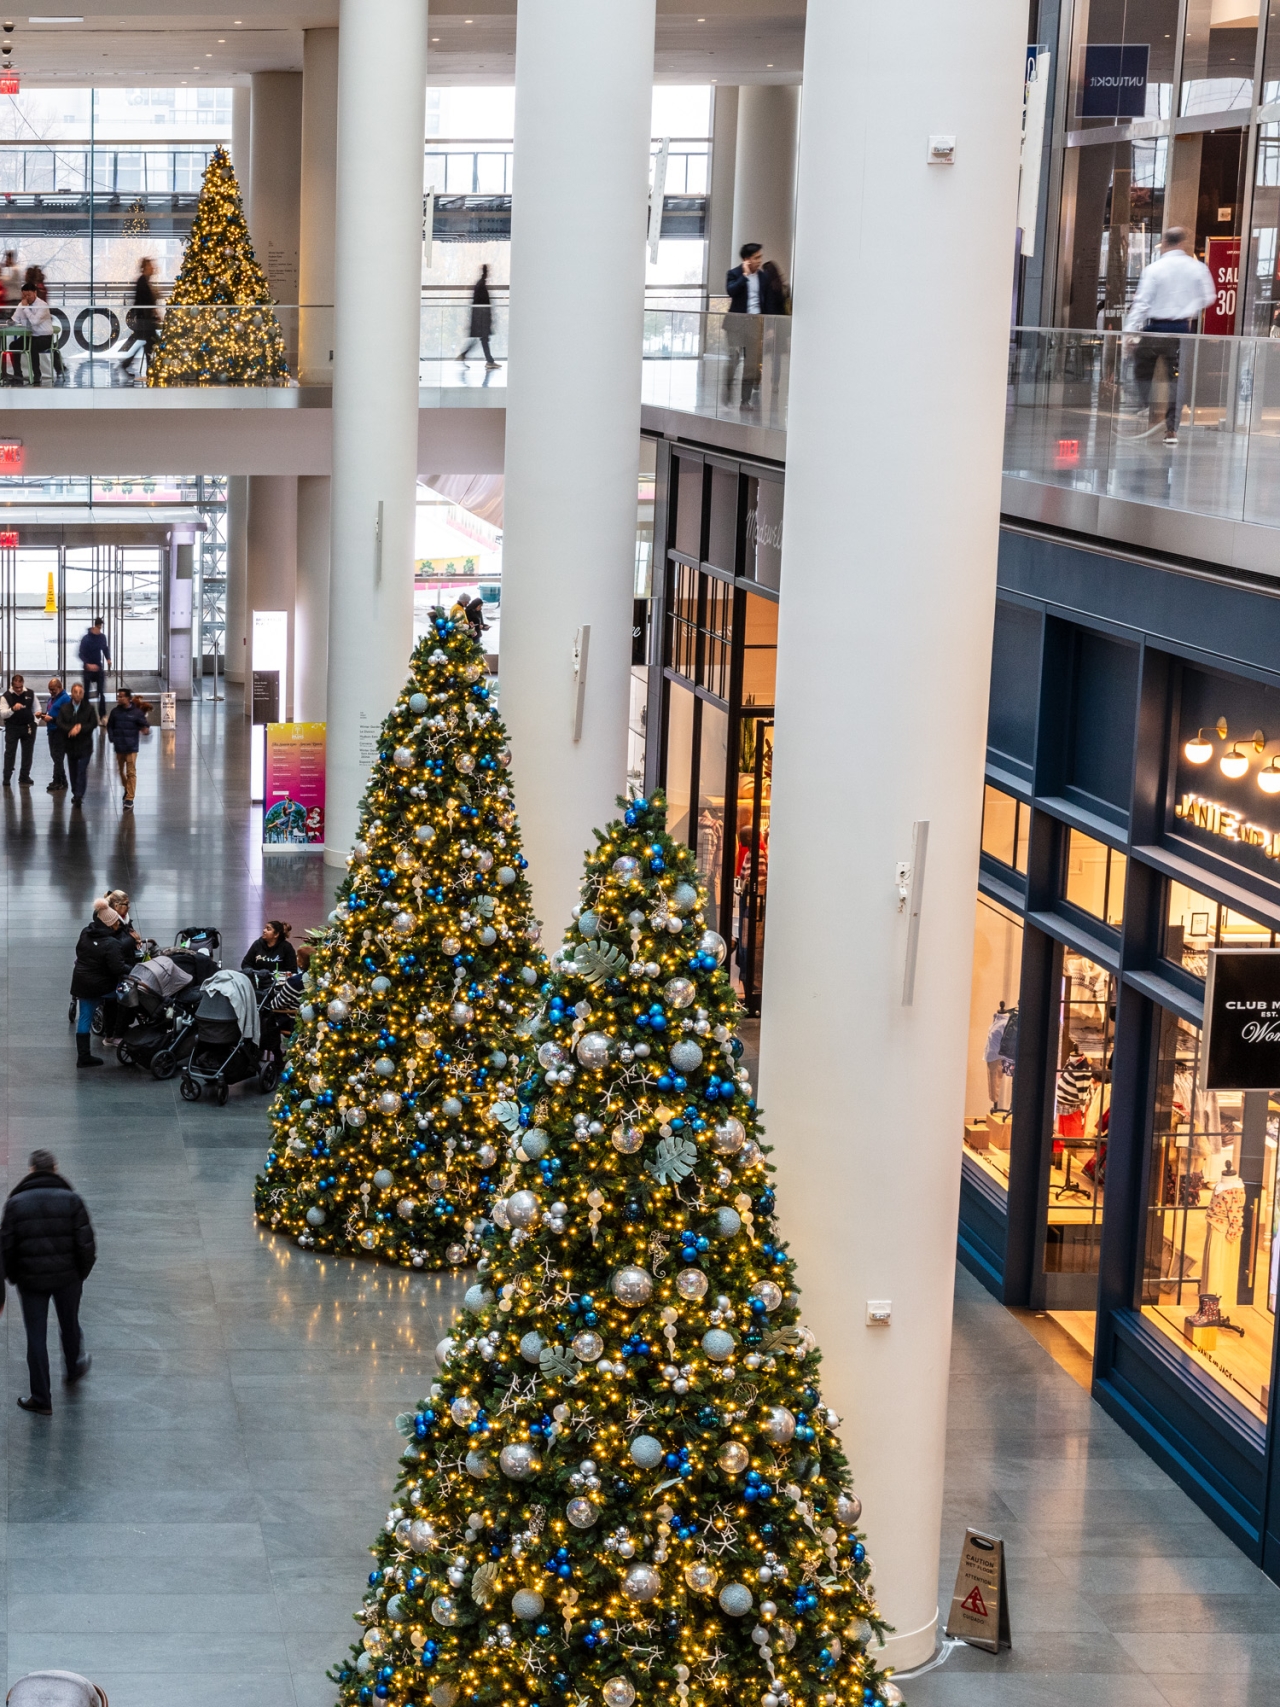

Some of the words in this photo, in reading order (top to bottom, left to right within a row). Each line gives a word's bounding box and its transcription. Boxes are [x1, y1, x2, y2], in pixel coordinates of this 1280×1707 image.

[1218, 267, 1239, 283] SAL
[1216, 290, 1236, 316] 30
[745, 509, 783, 549] Madewel
[1175, 794, 1238, 841] JANIE
[1225, 1001, 1268, 1010] CLUB
[1197, 1345, 1213, 1363] JANIE
[1219, 1364, 1233, 1381] JACK
[965, 1561, 976, 1569] WET
[966, 1553, 995, 1569] CAUTION
[965, 1573, 992, 1586] ATTENTION
[963, 1612, 985, 1625] CUIDADO
